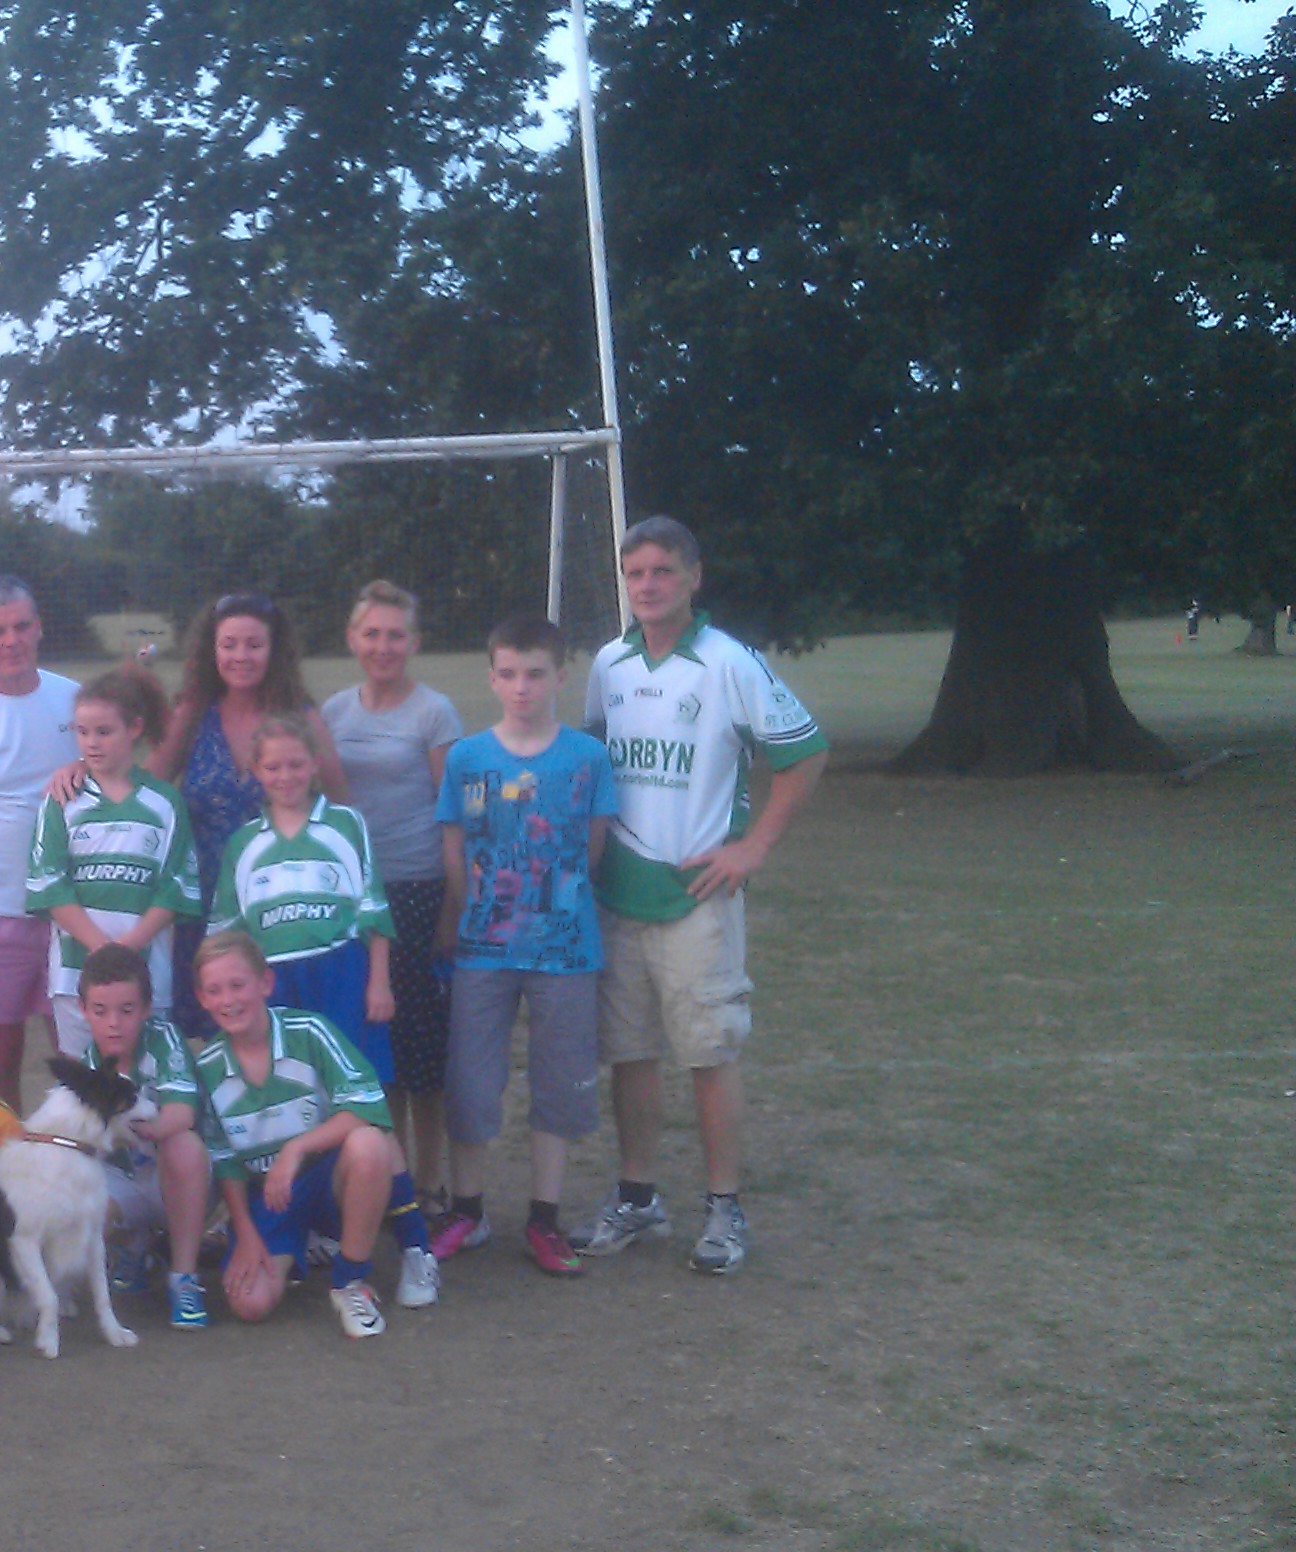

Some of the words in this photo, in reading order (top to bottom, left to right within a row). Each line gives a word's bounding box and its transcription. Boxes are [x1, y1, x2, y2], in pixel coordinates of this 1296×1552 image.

[608, 737, 695, 774] CORBYN
[73, 863, 153, 884] MURPHY
[260, 902, 337, 929] MURPHY
